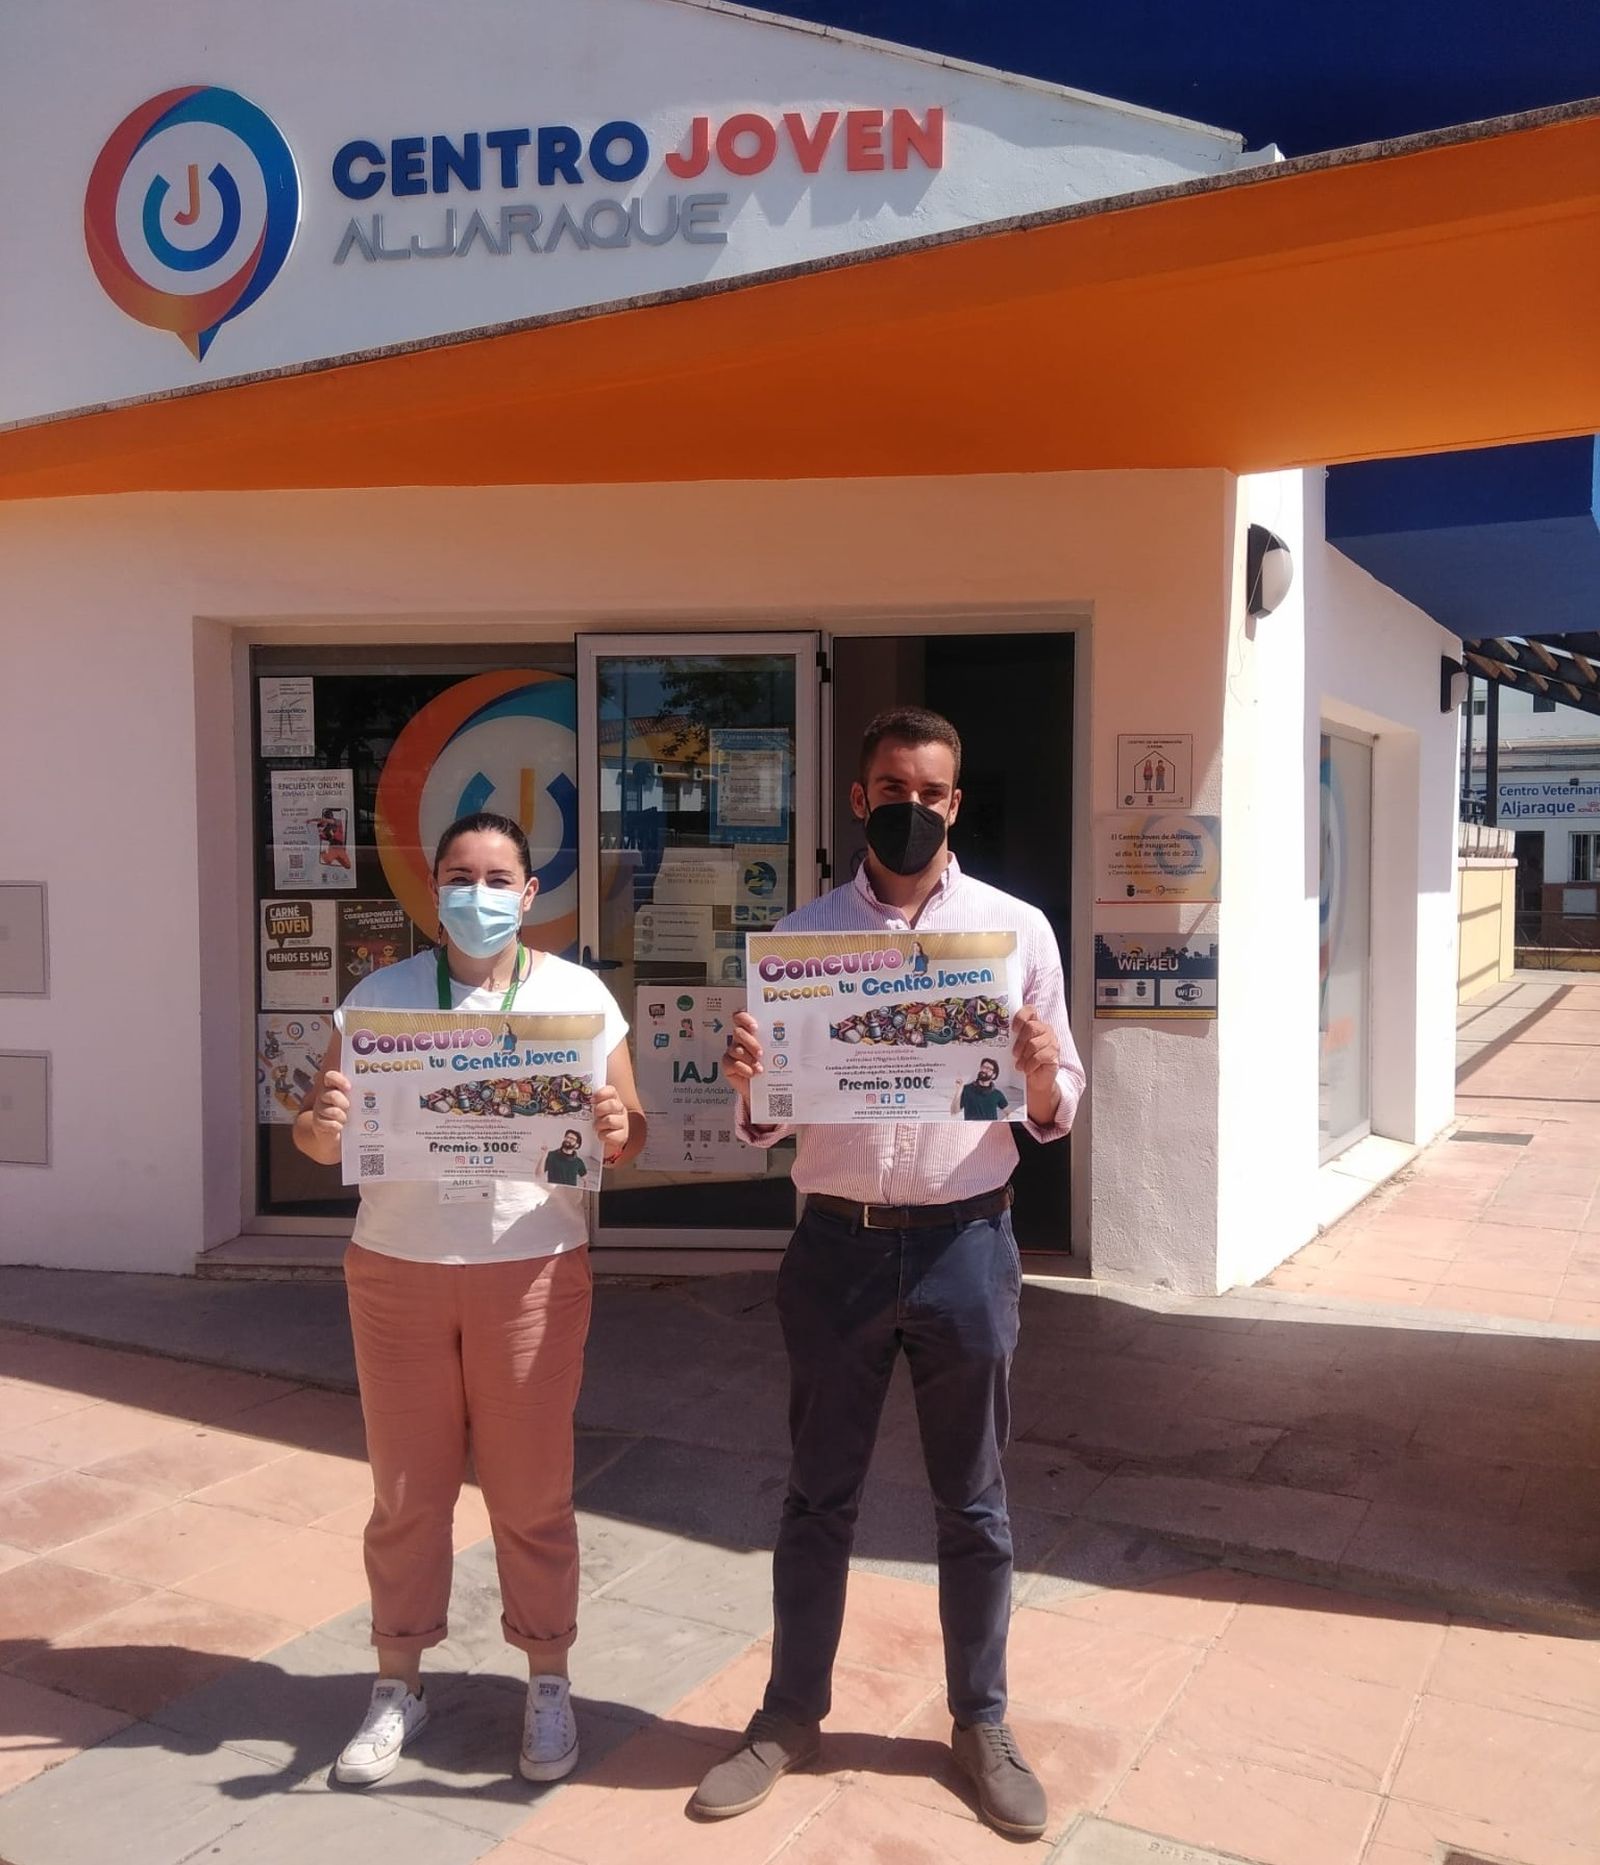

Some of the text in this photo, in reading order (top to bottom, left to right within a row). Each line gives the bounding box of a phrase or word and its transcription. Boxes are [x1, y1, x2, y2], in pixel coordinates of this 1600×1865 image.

[331, 107, 944, 201] CENTRO JOVEN
[333, 191, 730, 266] ALJARAQUE
[278, 781, 345, 790] ENCUESTA ONLINE
[1500, 786, 1539, 796] Centro
[1501, 801, 1575, 817] Aljaraque
[269, 905, 300, 918] CARNÉ
[271, 919, 310, 935] JOVEN
[269, 952, 298, 963] MENOS
[299, 952, 309, 962] ES
[759, 948, 904, 983] Concurso
[1118, 958, 1179, 971] WiFi4EU
[763, 966, 993, 1003] Decora tu Centro Joven
[352, 1028, 493, 1056] Concurso
[354, 1049, 578, 1075] Decora tu Centro Joven
[673, 1061, 718, 1083] IAJ
[838, 1076, 931, 1091] Premio 300€
[429, 1142, 518, 1153] Premio 300€
